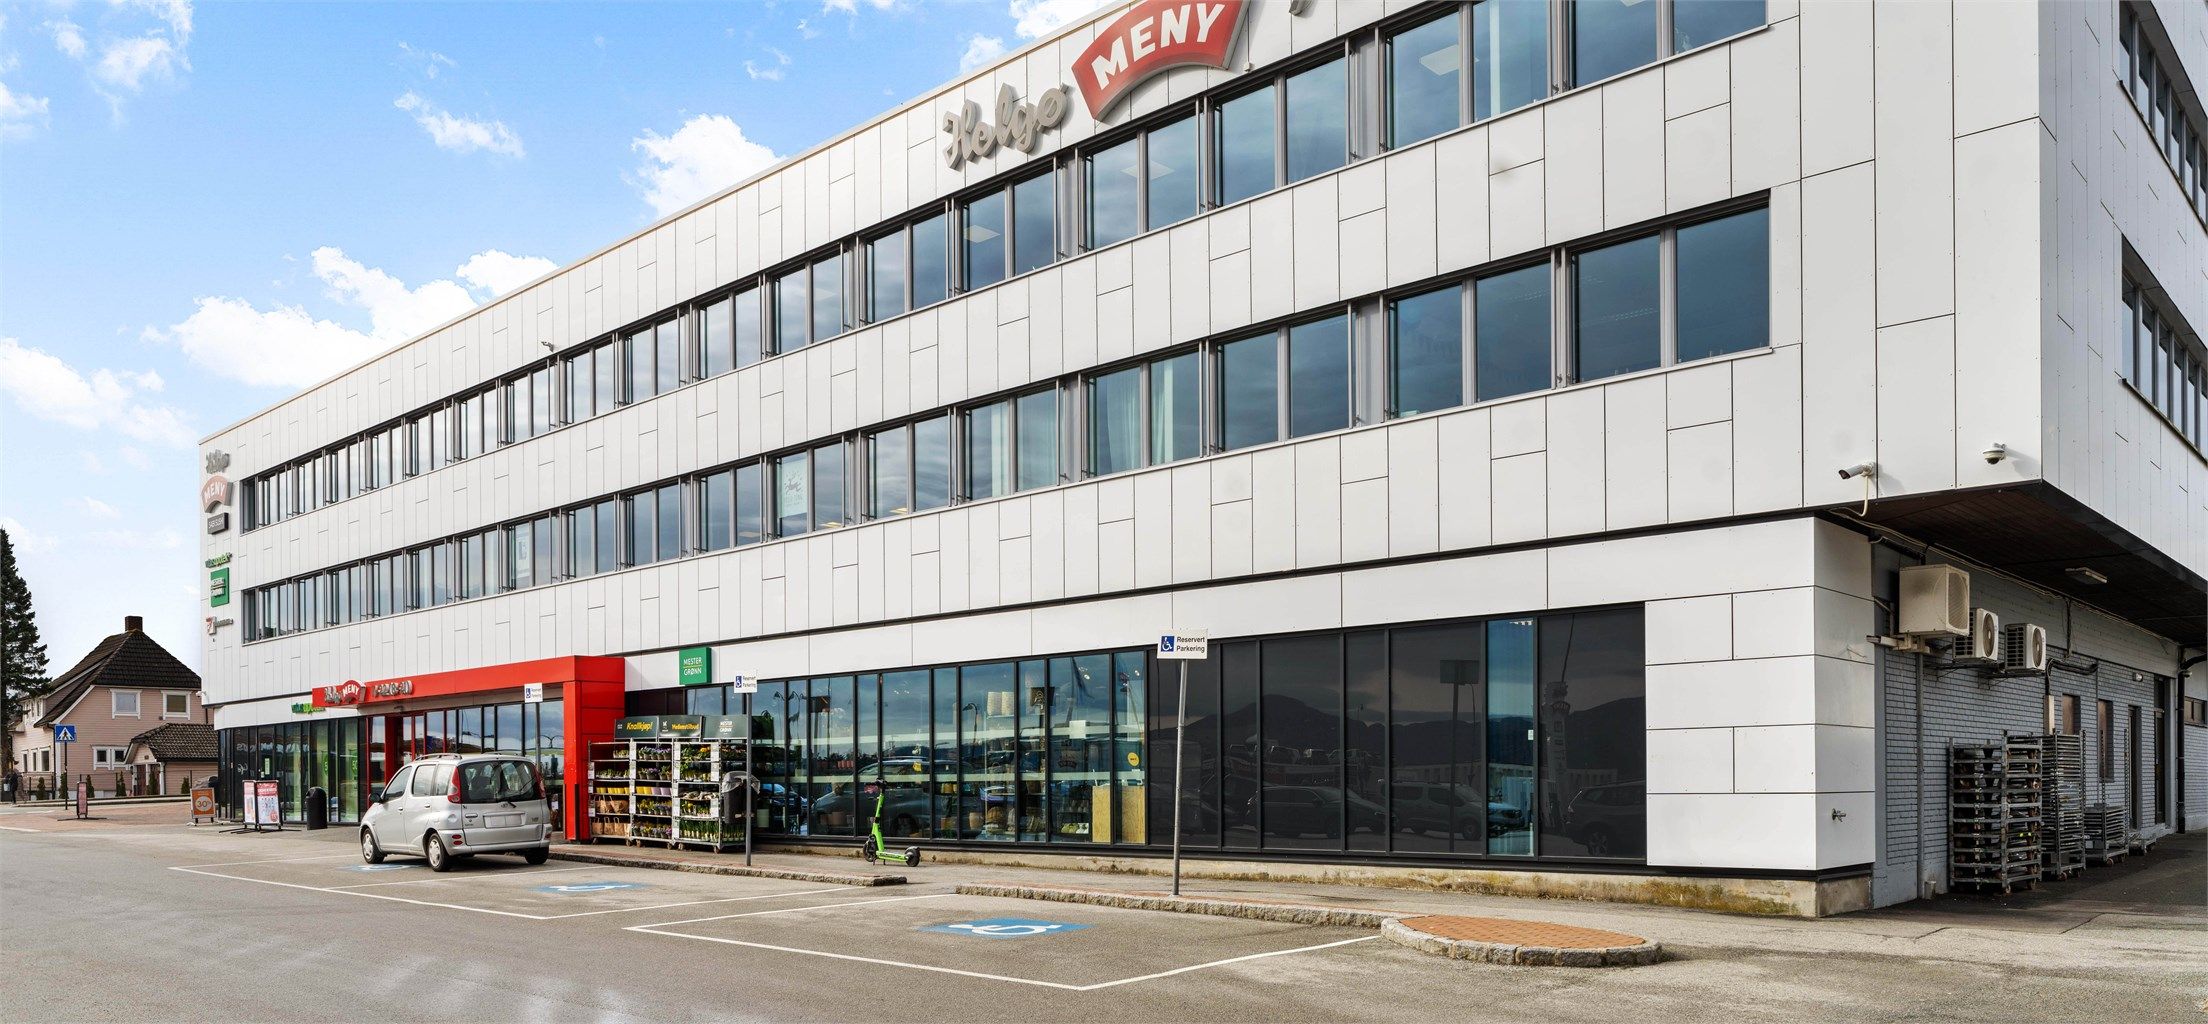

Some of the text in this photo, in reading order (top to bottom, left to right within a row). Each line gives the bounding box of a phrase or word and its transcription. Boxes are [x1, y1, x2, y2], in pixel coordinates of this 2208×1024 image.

[942, 3, 1226, 171] Helgø MENY
[204, 481, 226, 502] MENY
[1176, 645, 1205, 653] Parkering
[683, 656, 702, 665] MESTER
[683, 667, 702, 676] GRØNN
[342, 683, 360, 697] MENY
